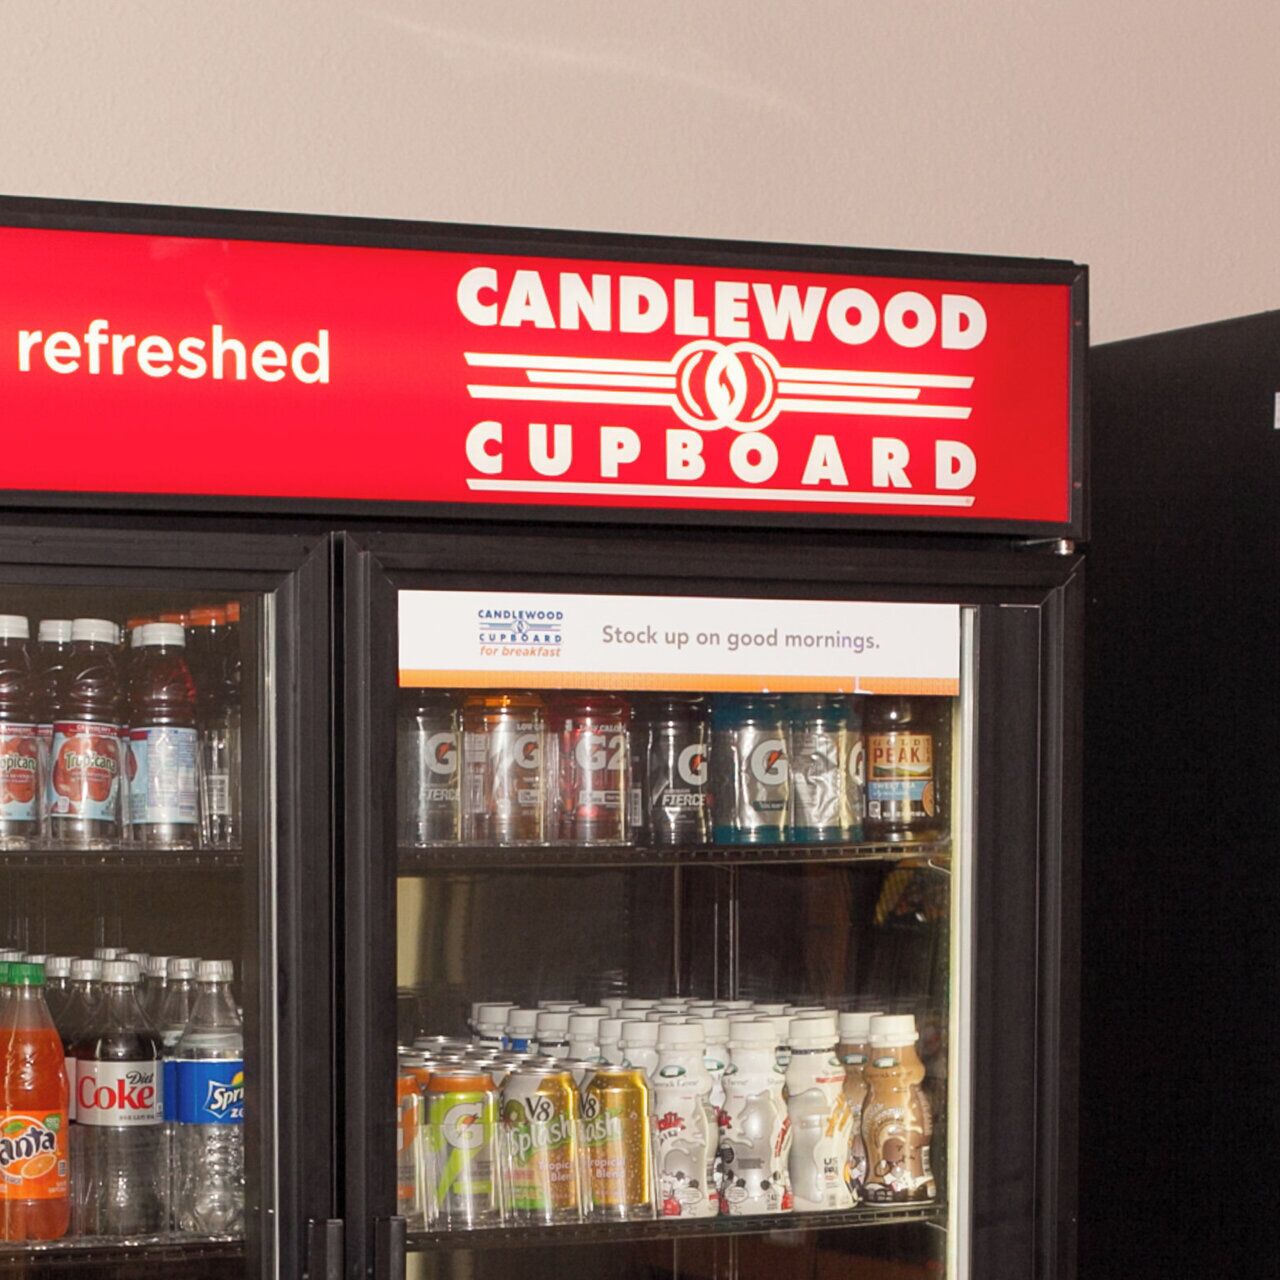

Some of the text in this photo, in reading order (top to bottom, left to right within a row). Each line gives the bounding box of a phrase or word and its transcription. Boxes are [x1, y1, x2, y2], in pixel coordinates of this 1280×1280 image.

[457, 267, 987, 350] CANDLEWOOD
[18, 319, 330, 384] refreshed
[465, 421, 976, 490] CUPBOARD
[478, 610, 563, 621] CANDLEWOOD
[479, 632, 562, 643] CUPBOARD
[480, 646, 561, 657] for breakfast
[602, 626, 880, 654] Stock up on good mornings.
[425, 733, 457, 774] G
[513, 734, 539, 769] G
[576, 735, 627, 770] G2
[678, 744, 708, 785] G
[751, 740, 788, 785] G
[874, 747, 920, 763] PEAK
[78, 1075, 155, 1110] Coke
[126, 1071, 154, 1084] Diet
[443, 1102, 484, 1149] G
[526, 1096, 551, 1122] V8
